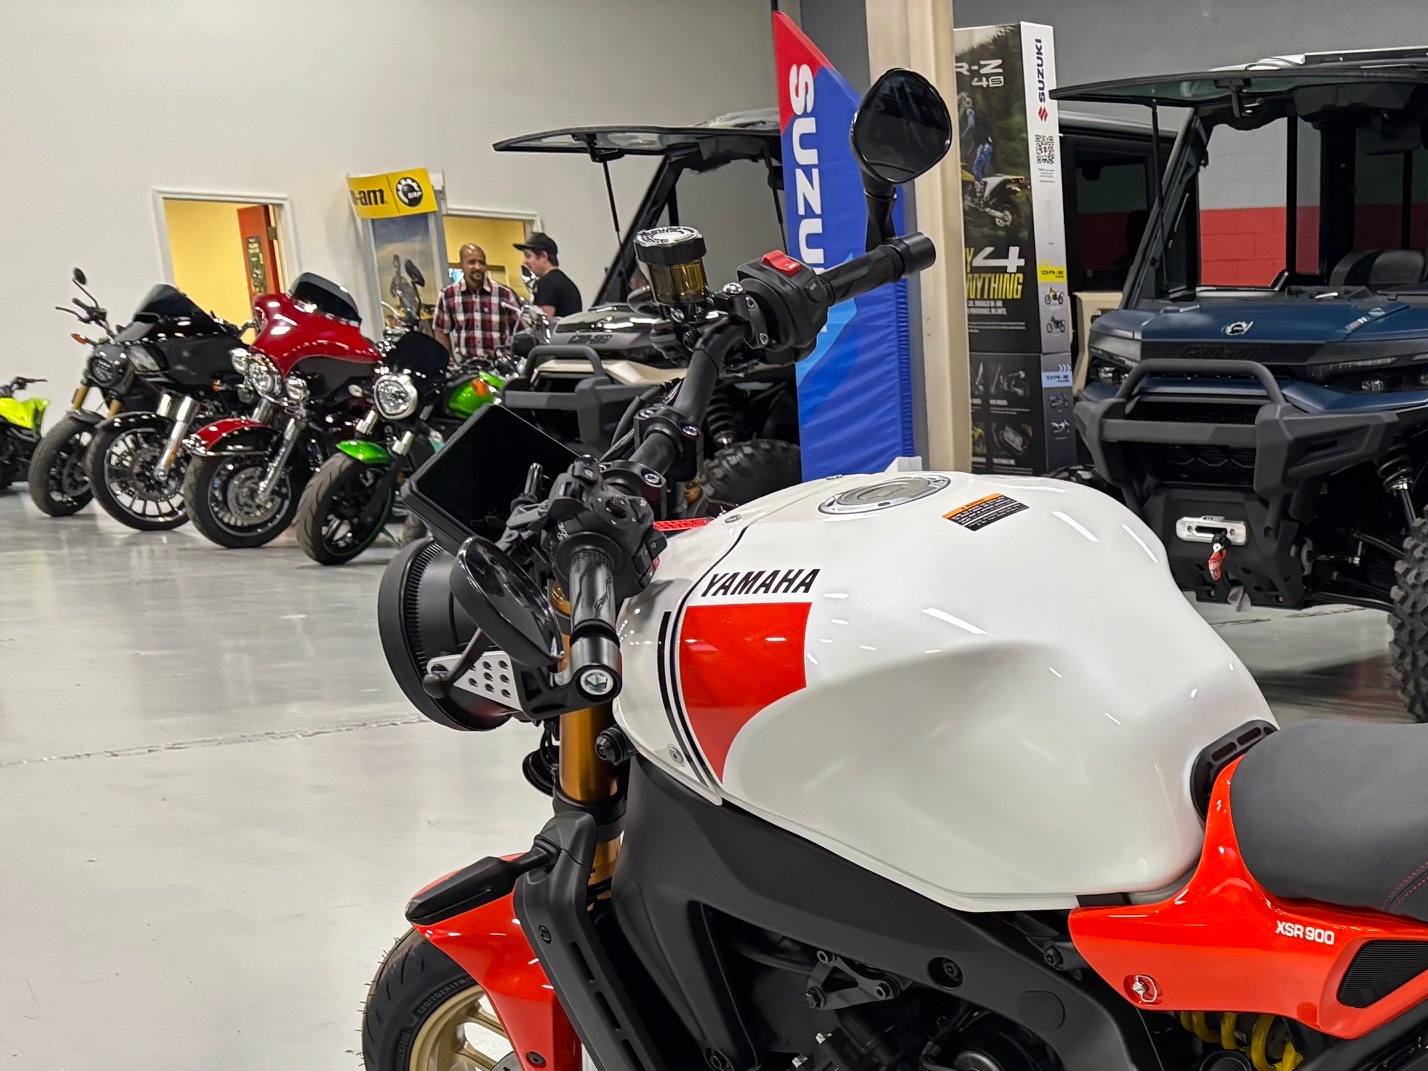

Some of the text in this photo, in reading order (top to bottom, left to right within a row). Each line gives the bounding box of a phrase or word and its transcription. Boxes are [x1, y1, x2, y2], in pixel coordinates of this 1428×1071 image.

[955, 59, 1003, 75] R-Z
[1035, 39, 1046, 103] SUZUKI
[789, 64, 827, 332] SUZU
[966, 273, 1024, 299] NYTHING
[701, 568, 821, 597] YAMAHA
[1275, 920, 1335, 945] XSR 900
